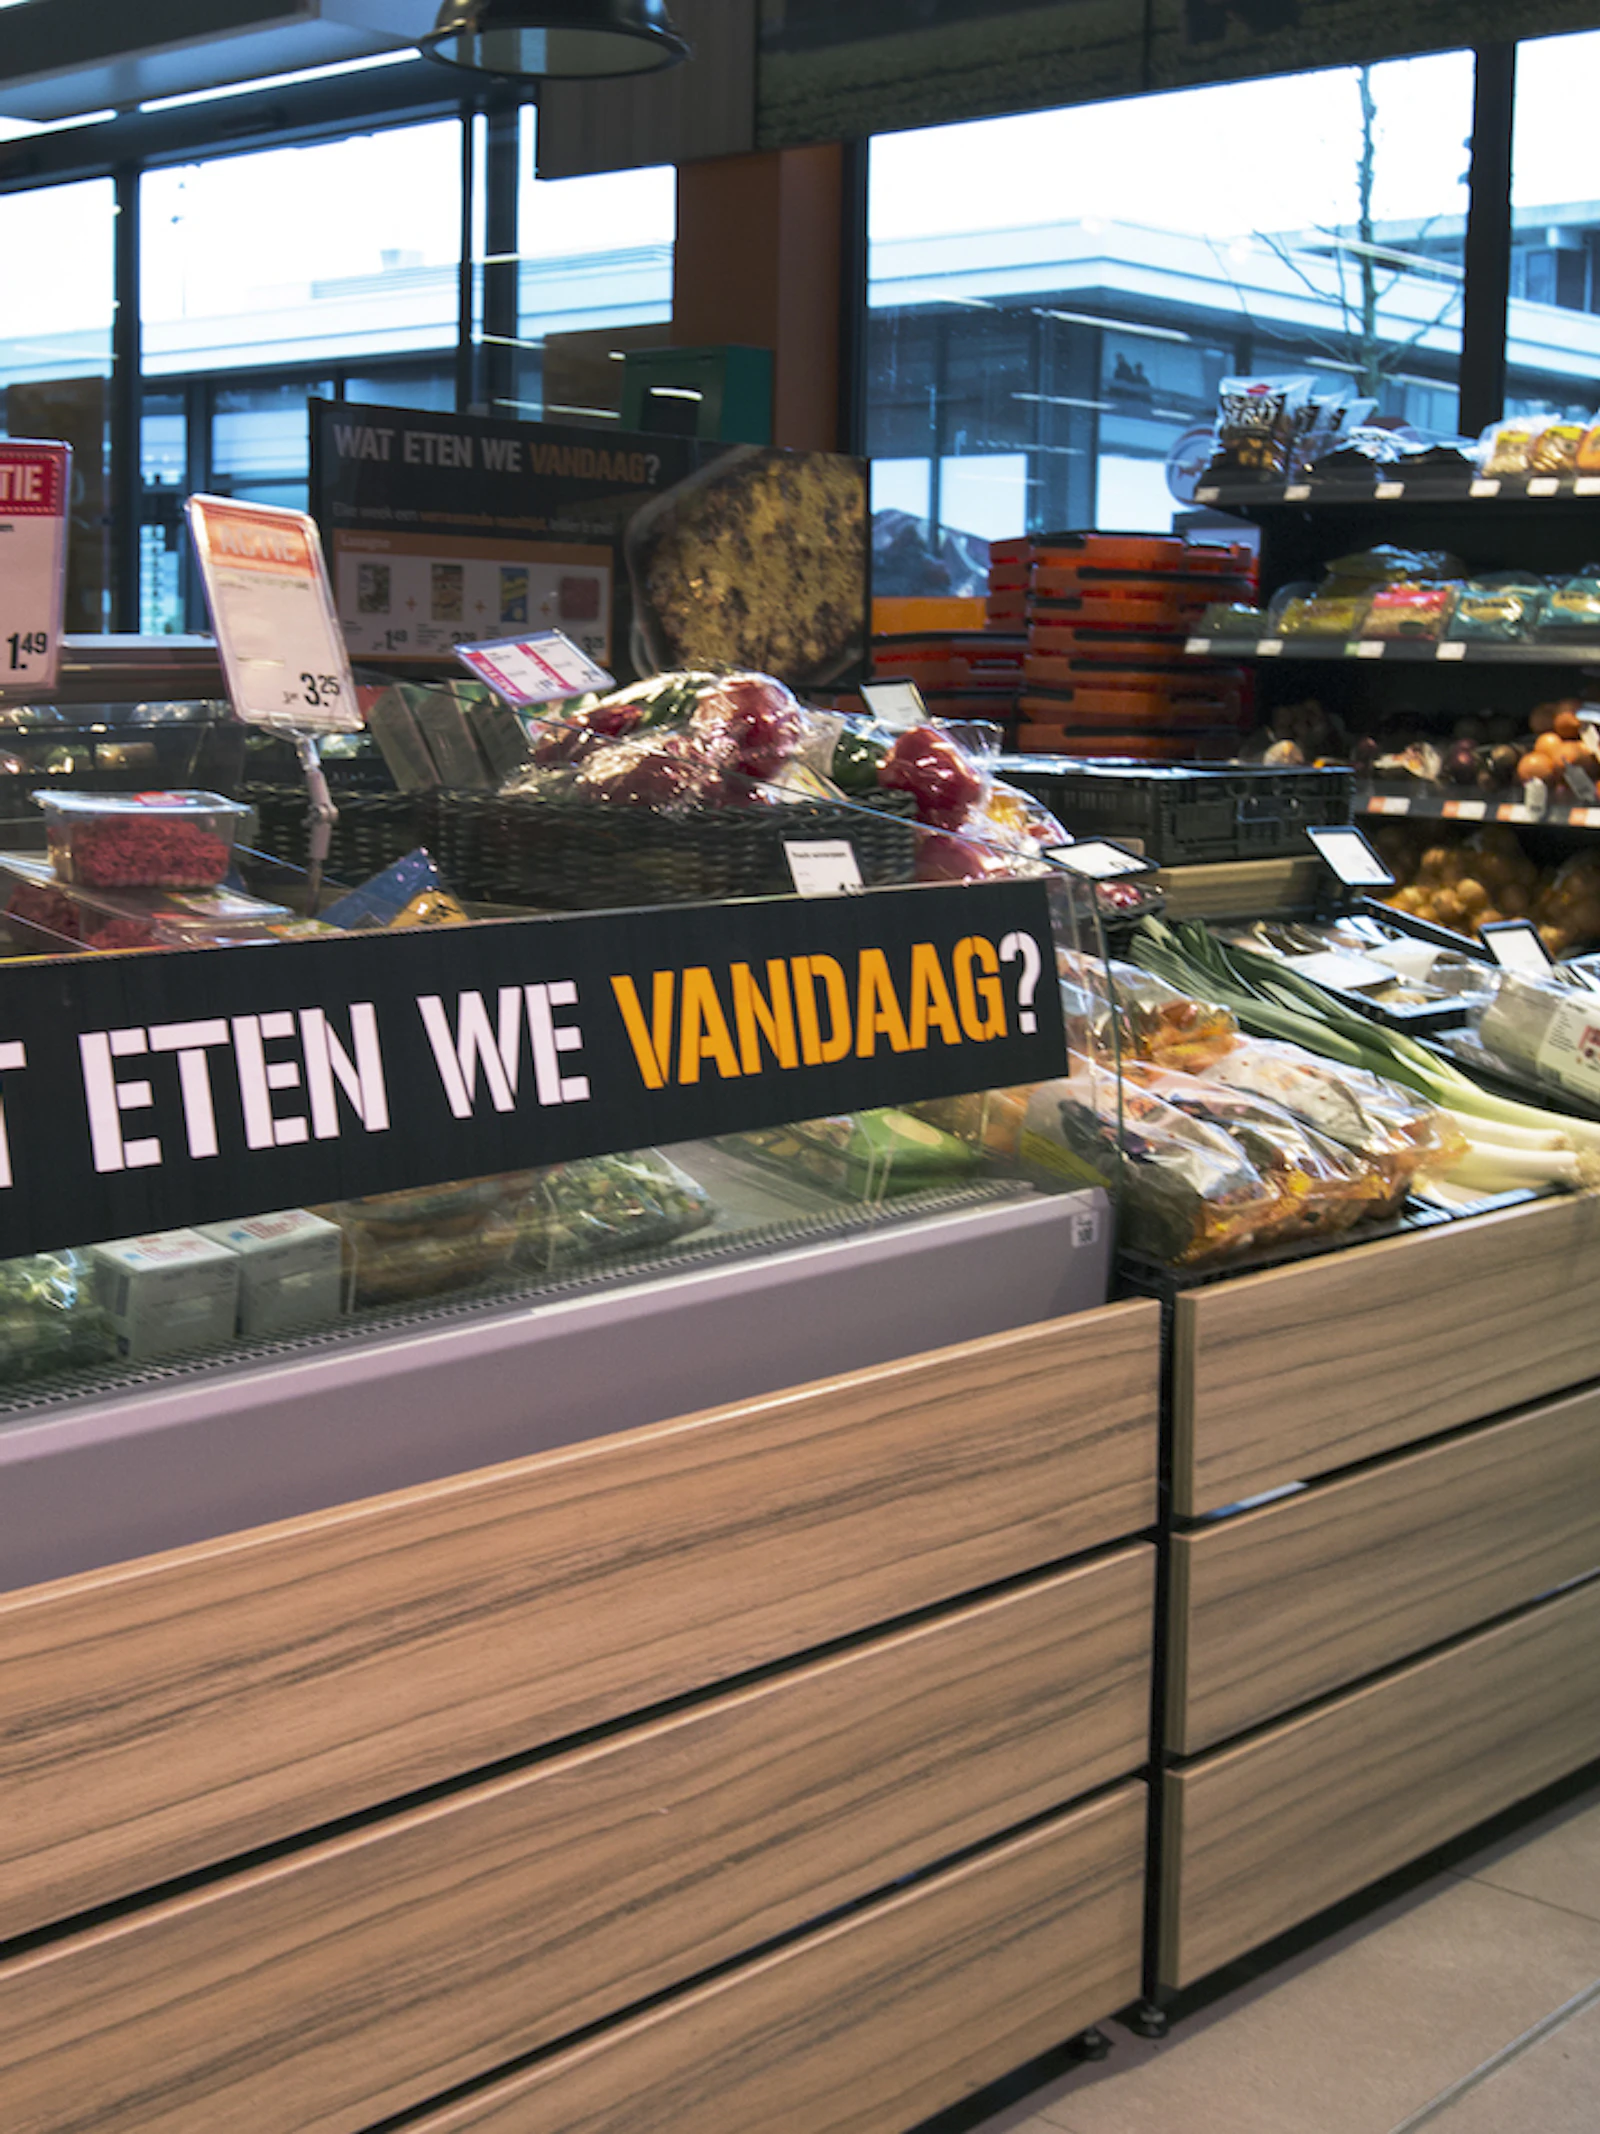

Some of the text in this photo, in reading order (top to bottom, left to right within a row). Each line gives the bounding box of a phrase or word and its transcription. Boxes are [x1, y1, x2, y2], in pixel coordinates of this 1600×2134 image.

[333, 423, 660, 484] WAT ETEN WE VANDAAG?
[219, 524, 298, 563] ACTIE
[6, 631, 49, 670] 1.49
[299, 671, 341, 707] 3.25
[79, 1001, 391, 1174] ETEN
[416, 979, 592, 1120] WE
[611, 930, 1043, 1091] VANDAAG?
